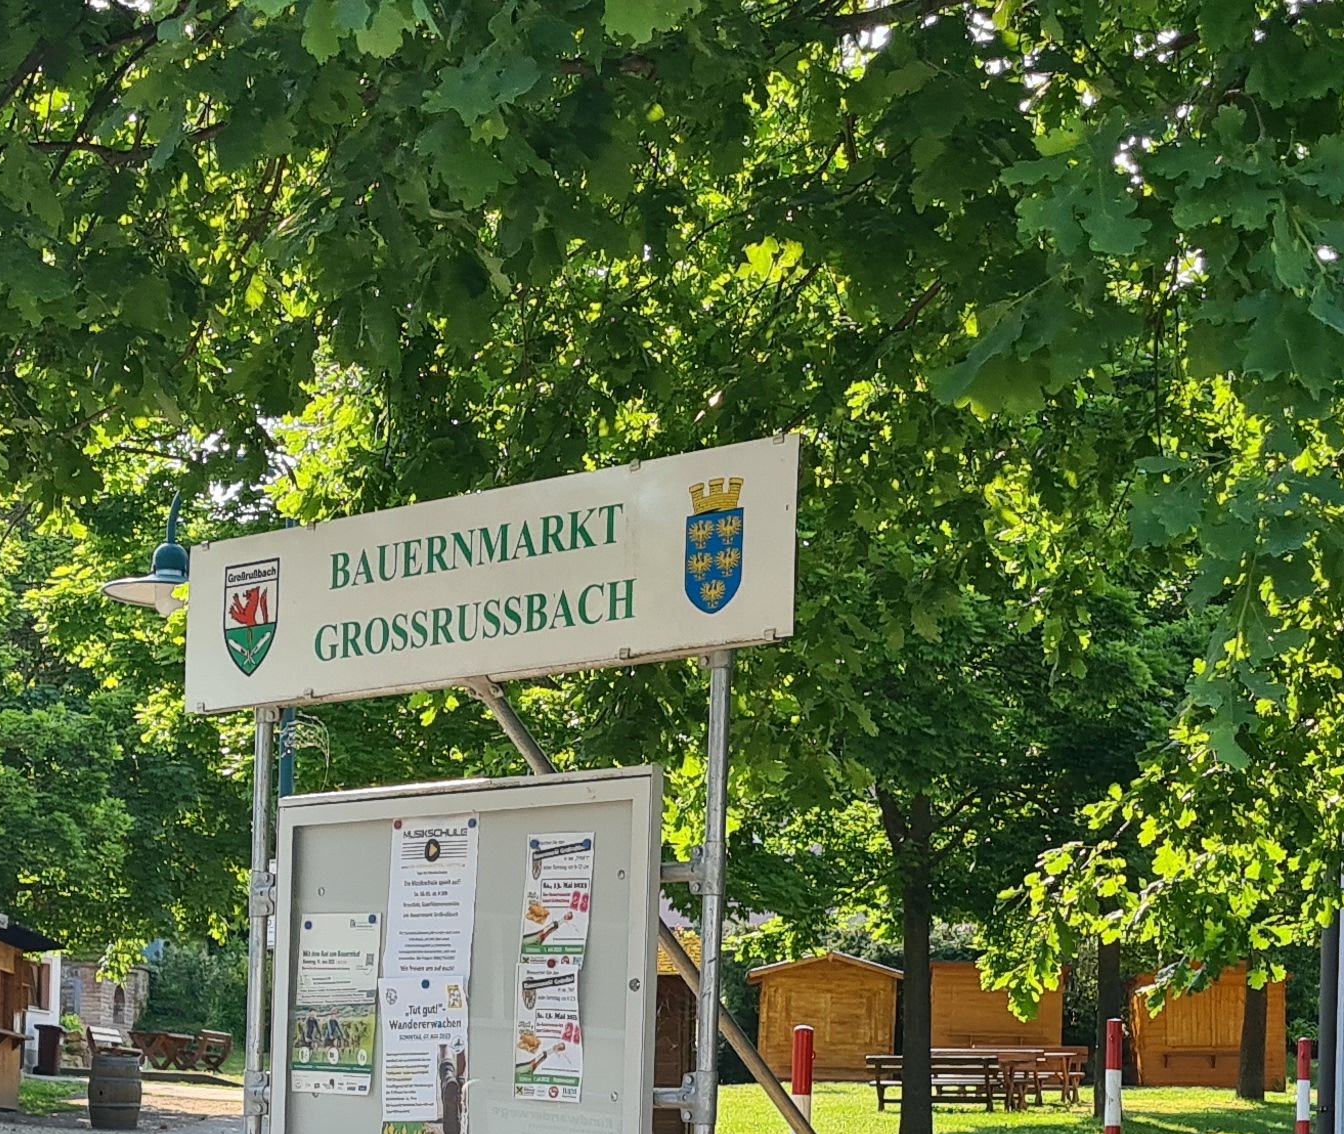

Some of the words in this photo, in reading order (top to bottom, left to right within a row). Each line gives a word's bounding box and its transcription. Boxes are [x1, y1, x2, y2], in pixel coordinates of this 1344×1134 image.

[328, 503, 624, 590] BAUERNMARKT
[227, 566, 277, 583] Großrußbach
[314, 578, 638, 662] GROSSRUSSBACH
[402, 827, 468, 839] MUSIKSCHULE
[389, 1016, 462, 1030] Wandererwachen
